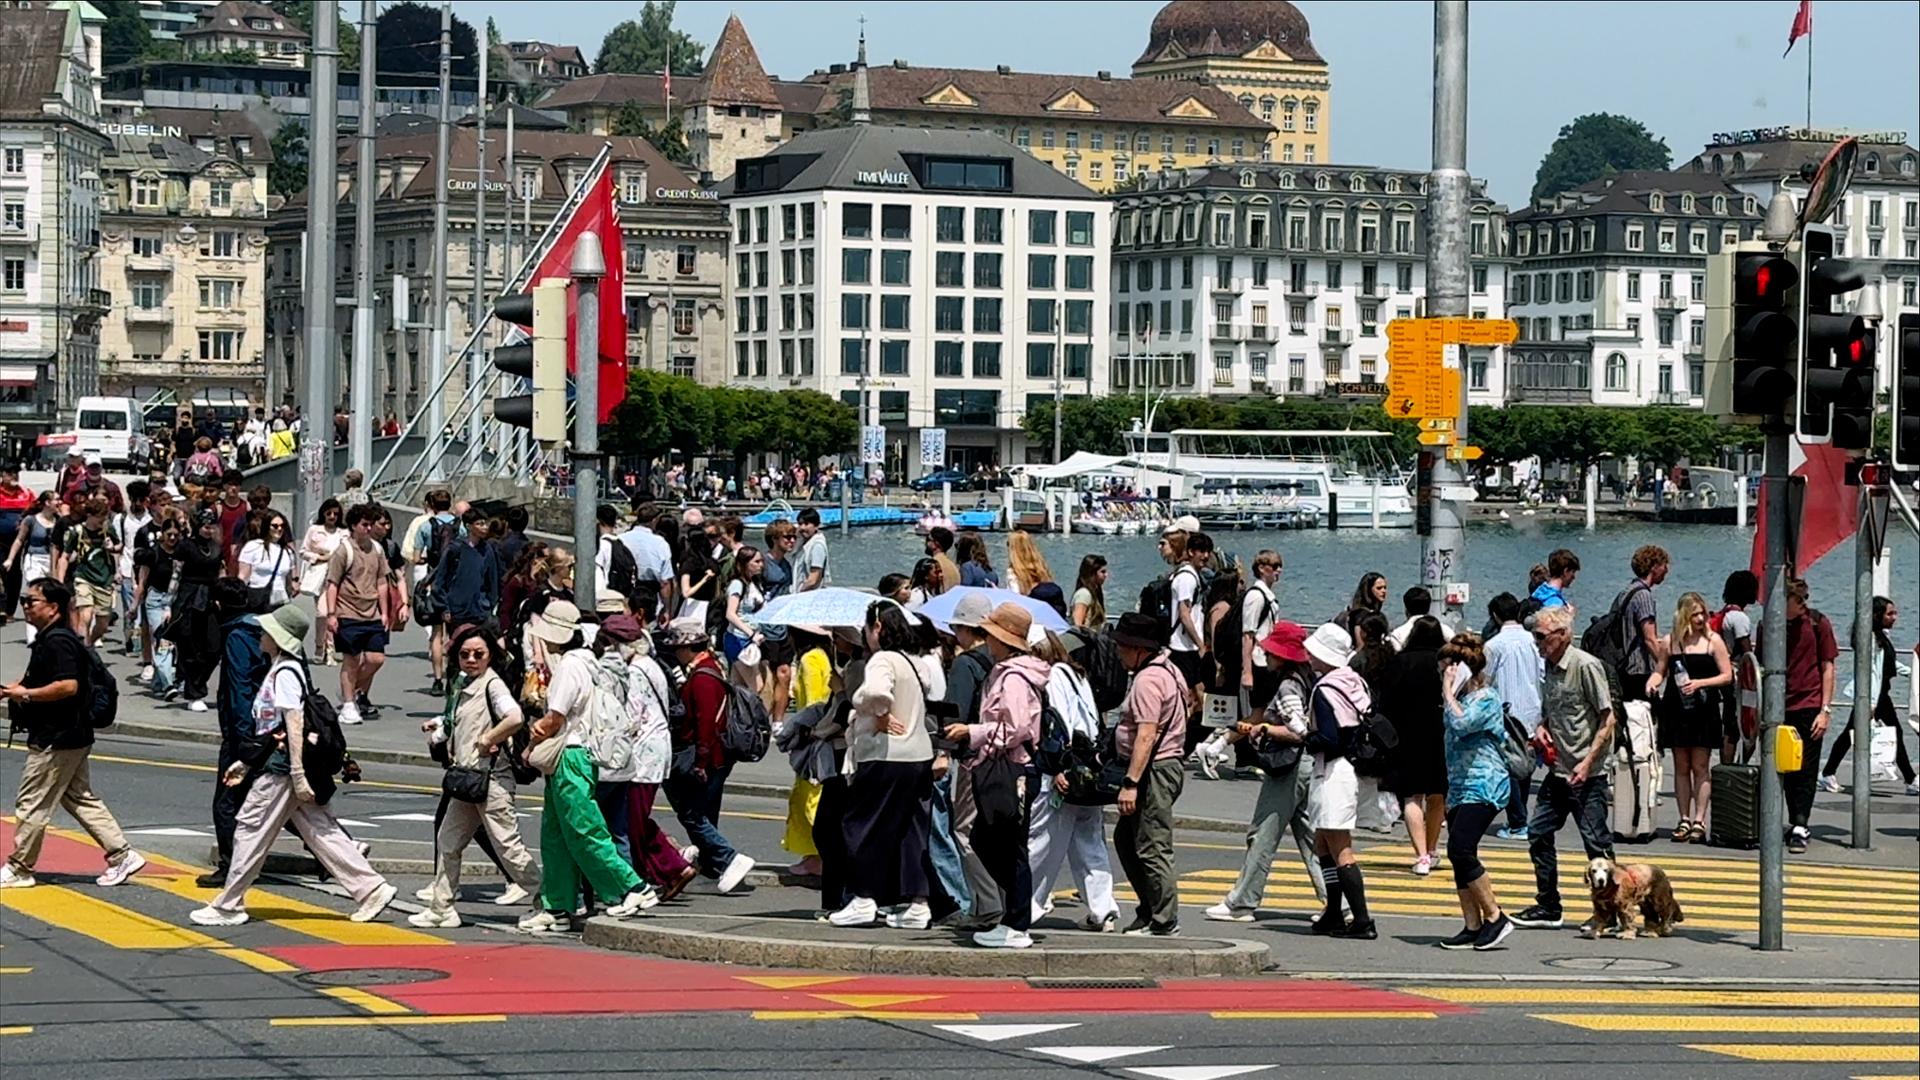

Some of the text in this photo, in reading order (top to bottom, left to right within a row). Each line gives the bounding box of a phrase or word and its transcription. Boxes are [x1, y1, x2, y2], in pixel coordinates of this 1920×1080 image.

[447, 179, 477, 190] CREDI
[655, 187, 719, 201] CREDIT SUISSE
